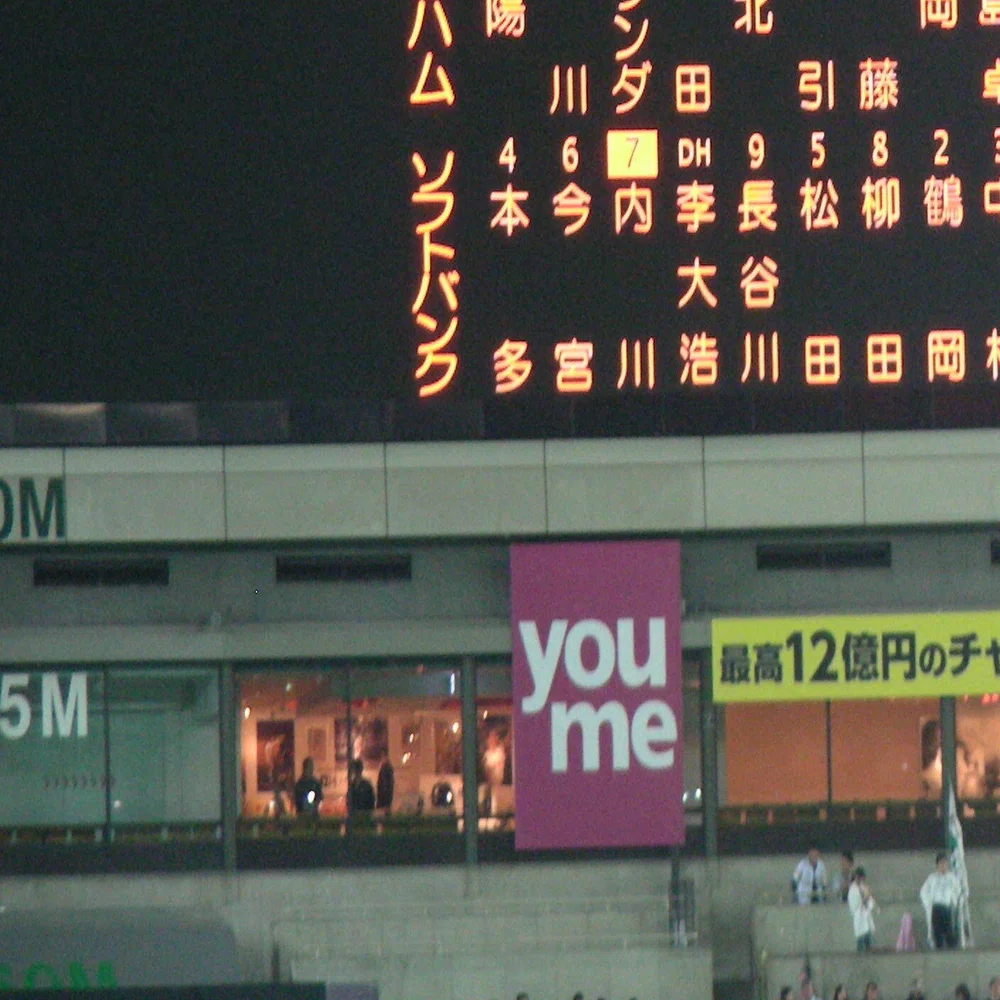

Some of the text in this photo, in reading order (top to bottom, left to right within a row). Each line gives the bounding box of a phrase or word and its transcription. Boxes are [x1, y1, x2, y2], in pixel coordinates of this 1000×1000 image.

[499, 137, 516, 172] 4
[562, 136, 578, 172] 6
[624, 137, 639, 169] 7
[678, 138, 711, 168] DH
[748, 133, 765, 169] 9
[811, 132, 825, 168] 5
[872, 130, 888, 167] 8
[934, 129, 949, 166] 2
[411, 151, 460, 397] ソフトバンク
[518, 617, 667, 714] you
[551, 698, 678, 772] me
